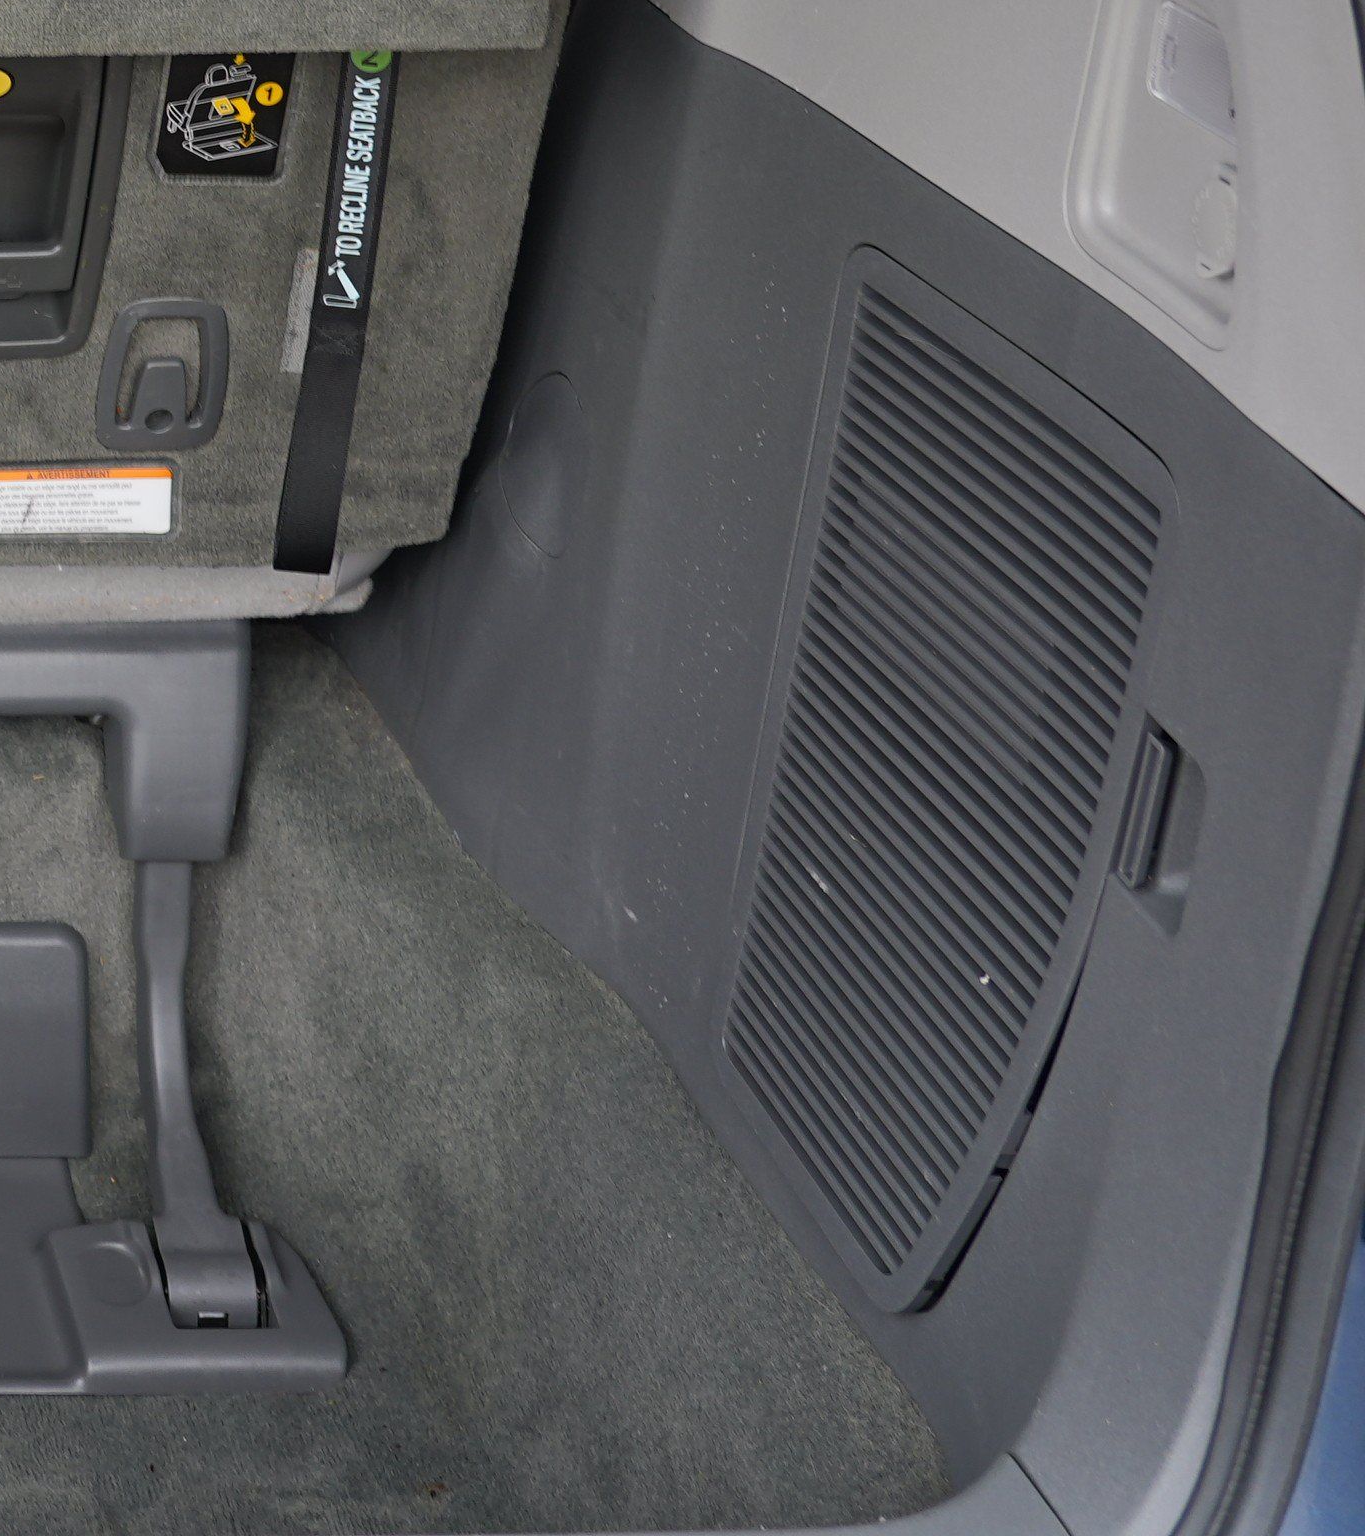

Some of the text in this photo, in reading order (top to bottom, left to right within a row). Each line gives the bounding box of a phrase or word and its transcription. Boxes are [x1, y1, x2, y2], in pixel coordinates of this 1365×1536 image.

[265, 88, 273, 101] 1
[335, 75, 381, 257] TO RECLINE SEATBACK
